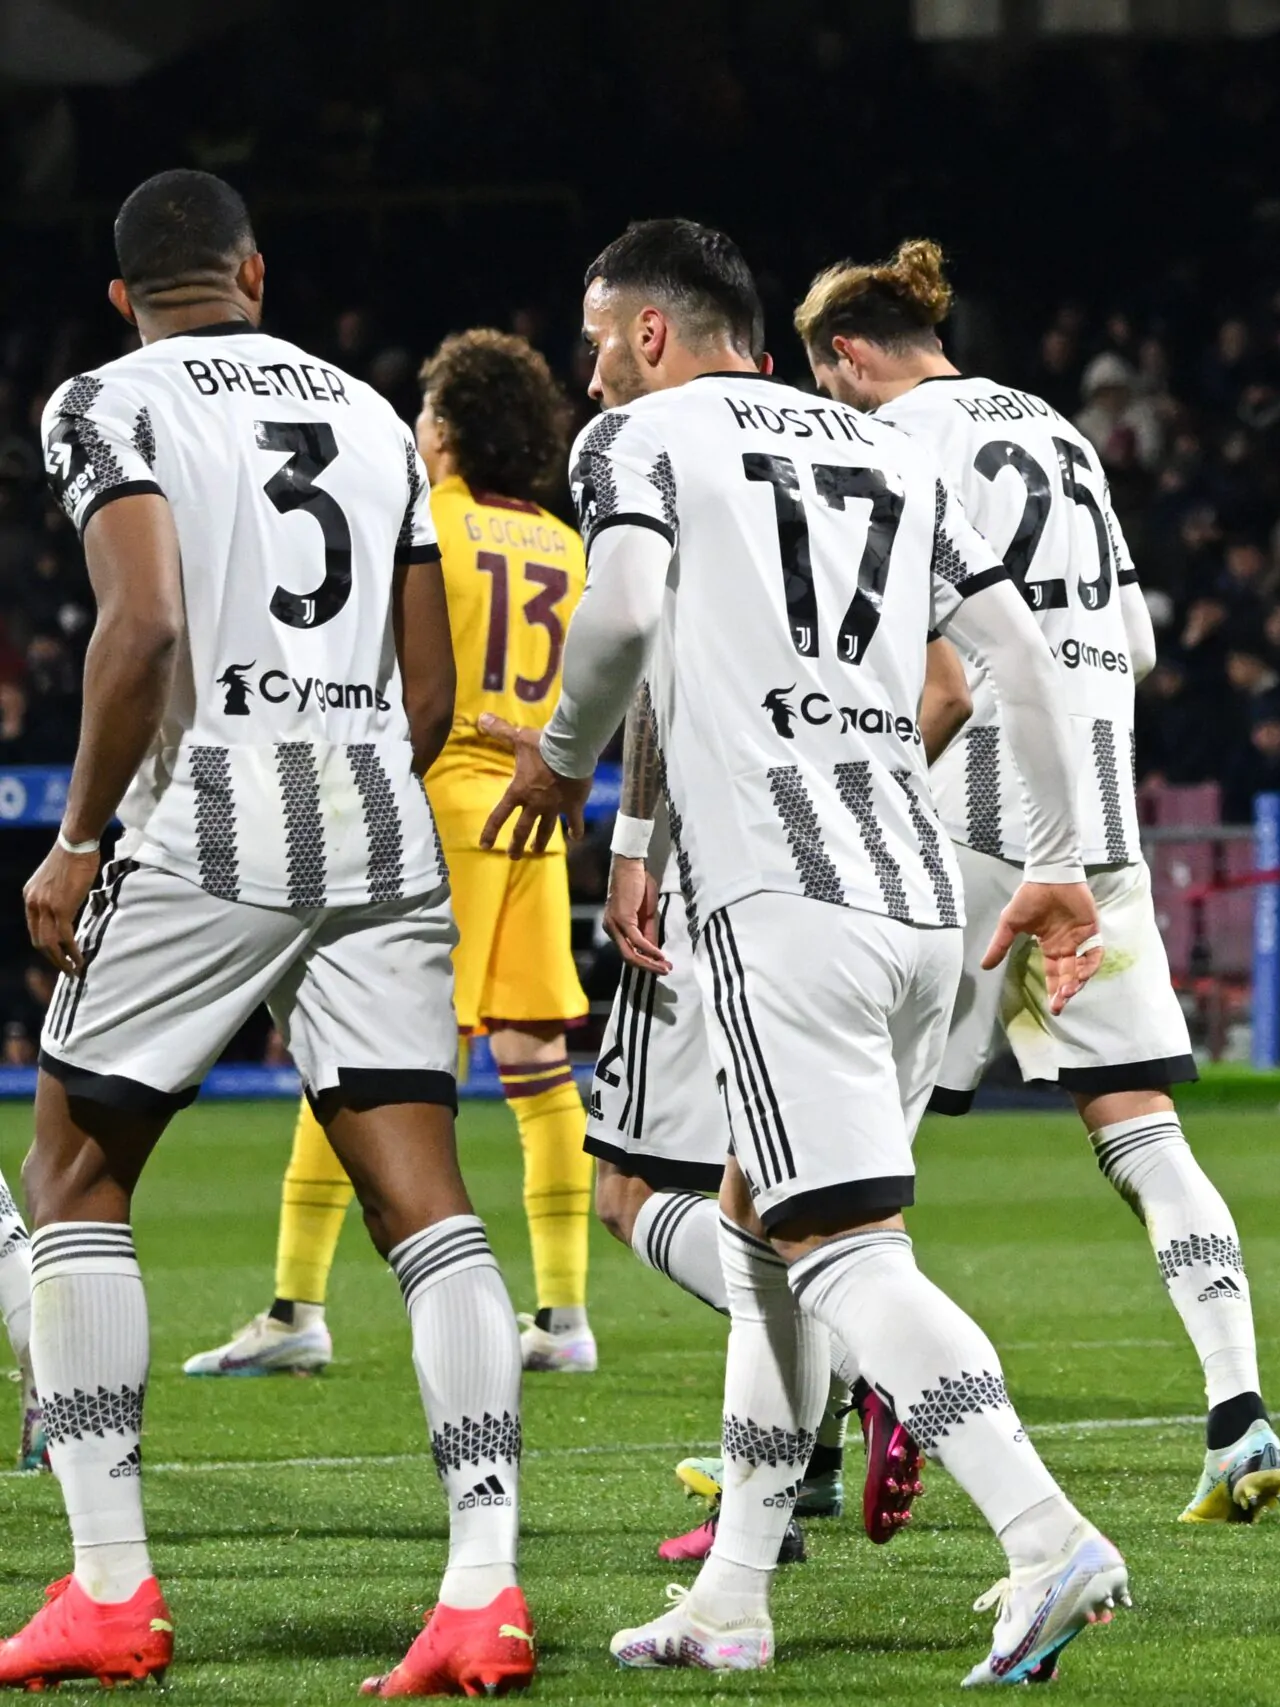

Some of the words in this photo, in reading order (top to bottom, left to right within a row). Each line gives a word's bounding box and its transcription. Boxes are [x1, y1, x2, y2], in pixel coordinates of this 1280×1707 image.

[182, 358, 351, 406] BREMER
[254, 420, 352, 629] 3
[741, 452, 905, 666] 17
[973, 436, 1113, 612] 25
[476, 551, 569, 704] 13
[457, 1494, 512, 1511] adidas
